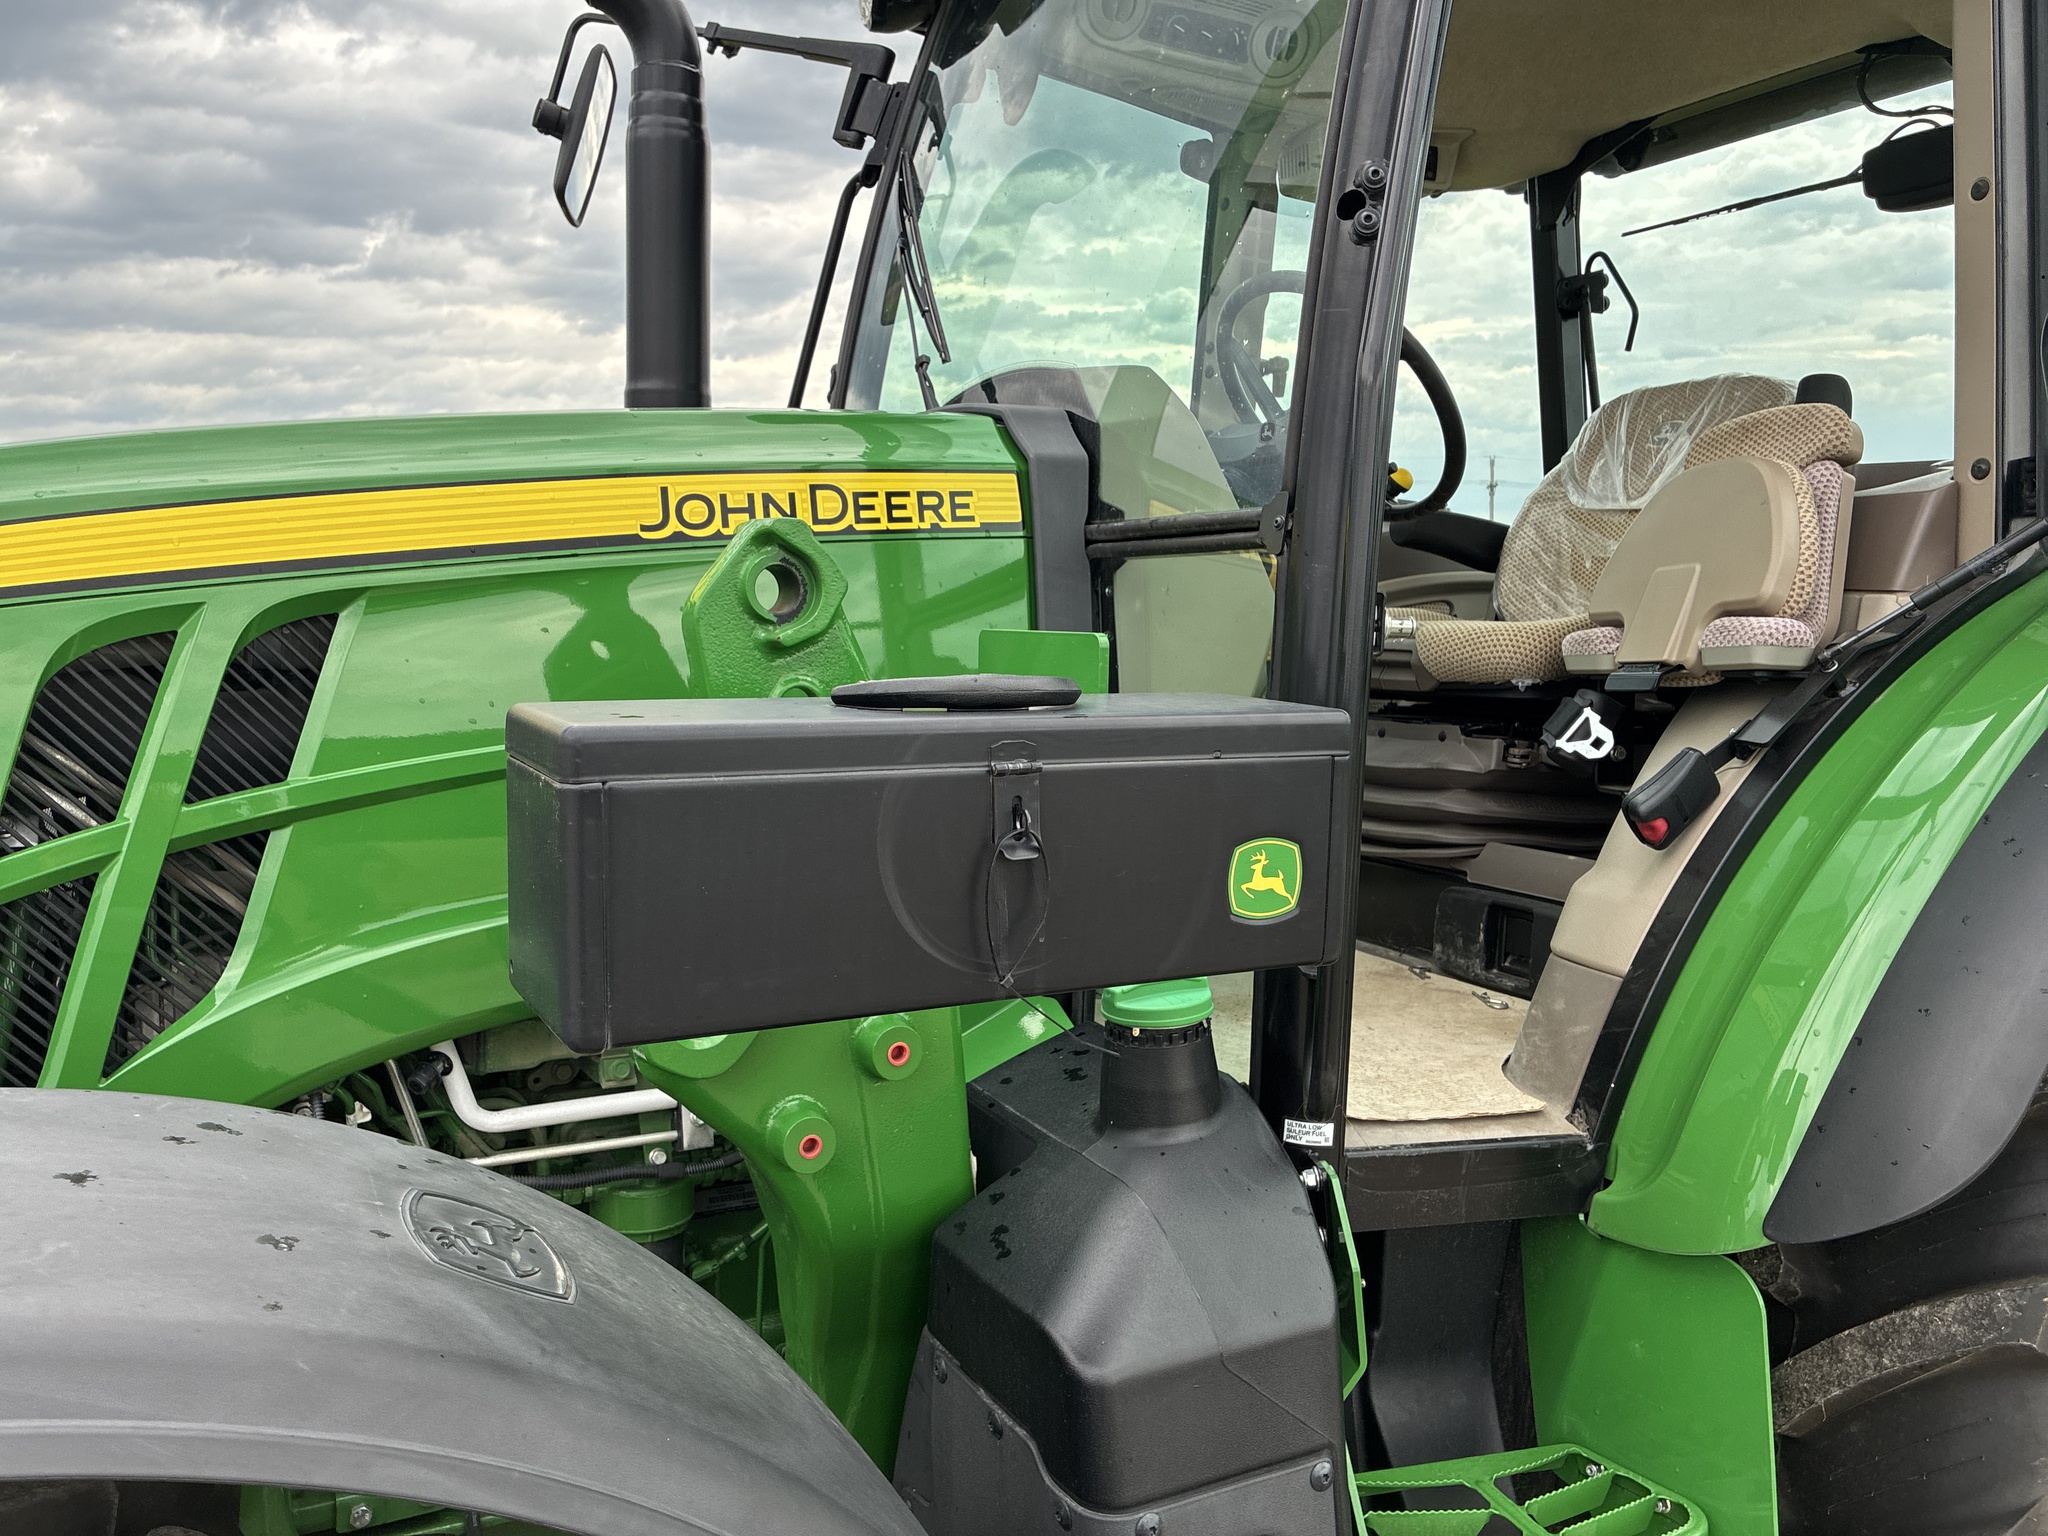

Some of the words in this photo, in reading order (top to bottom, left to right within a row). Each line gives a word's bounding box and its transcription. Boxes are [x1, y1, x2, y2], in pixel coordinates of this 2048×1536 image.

[639, 485, 797, 533] JOHN
[808, 484, 976, 526] DEERE
[1287, 1121, 1307, 1129] ULTRA
[1286, 1127, 1311, 1136] SULFUR
